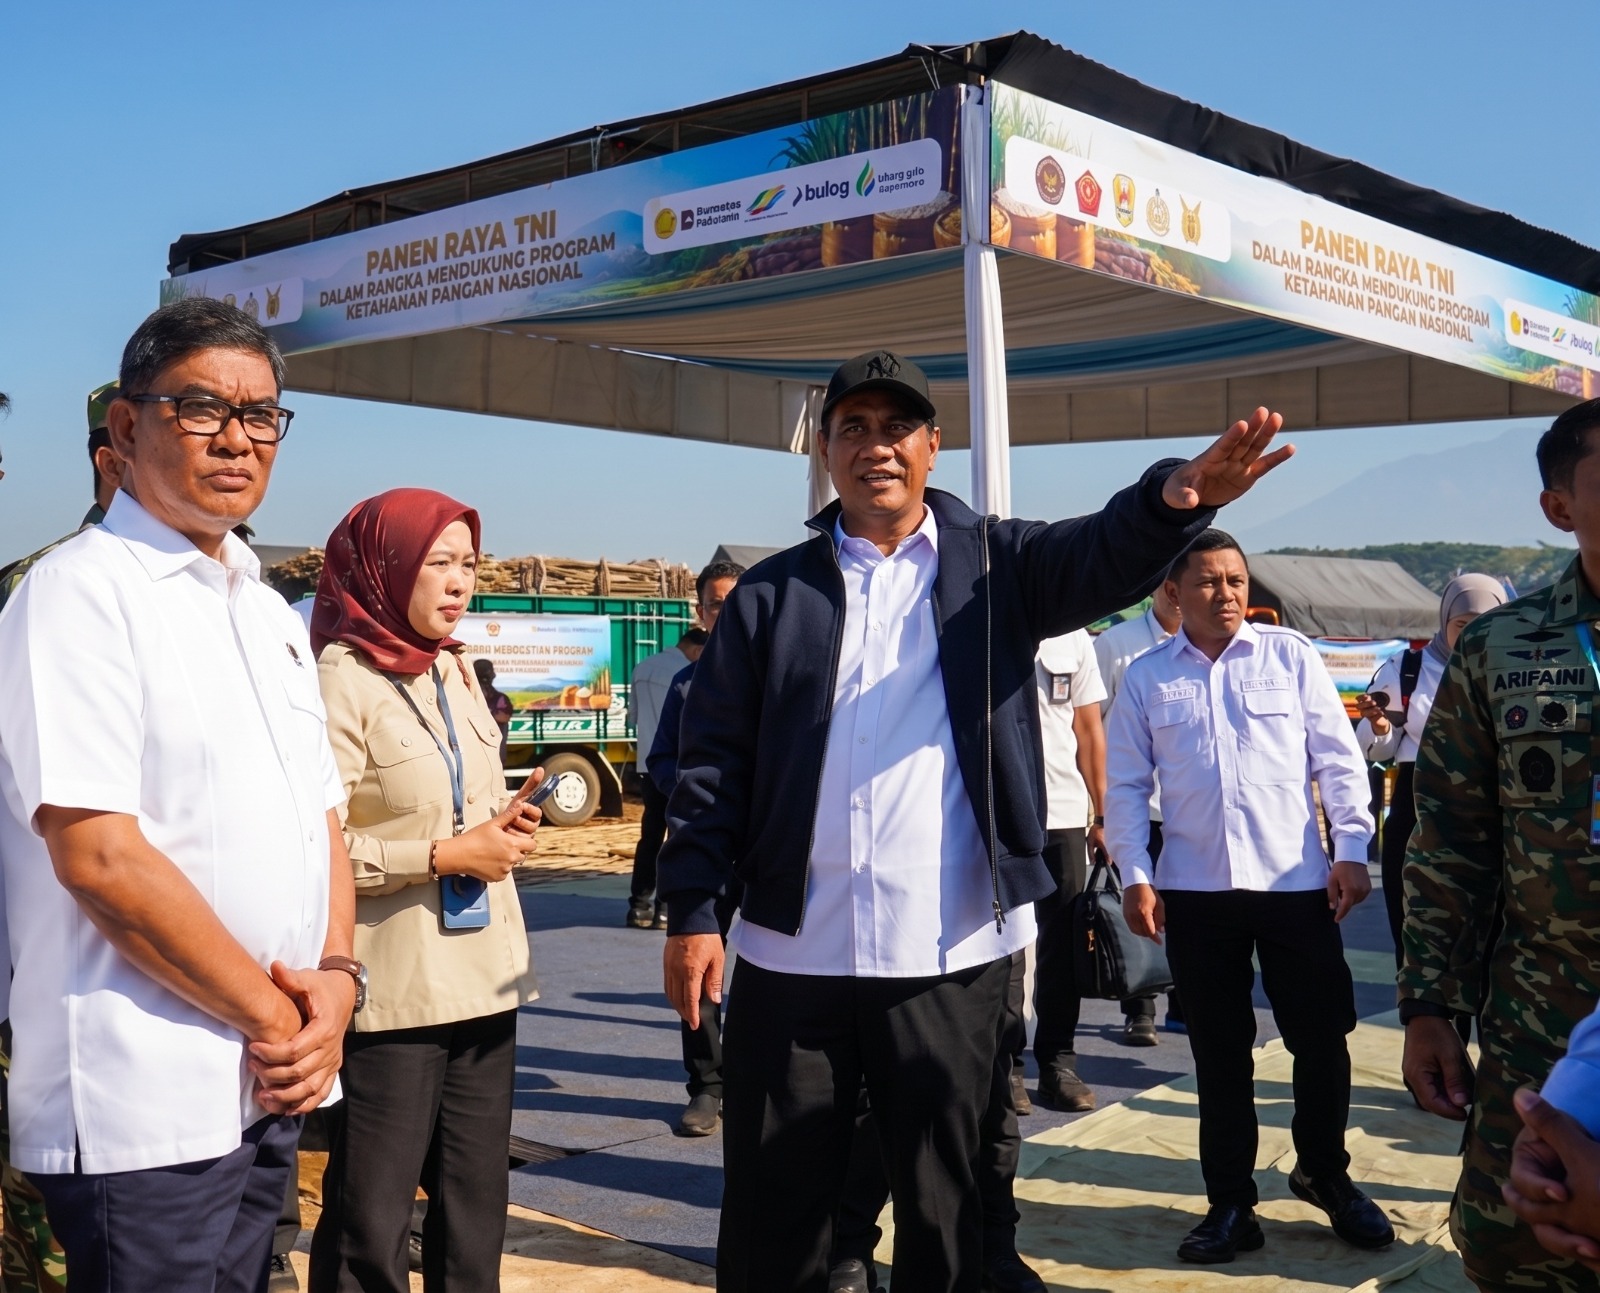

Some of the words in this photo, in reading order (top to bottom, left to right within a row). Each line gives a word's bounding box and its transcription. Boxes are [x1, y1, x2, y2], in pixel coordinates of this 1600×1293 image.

[805, 180, 850, 201] bulog
[320, 283, 364, 308] DALAM
[367, 272, 424, 298] RANGKA
[427, 250, 525, 286] MENDUKUNG
[530, 231, 616, 266] PROGRAM
[366, 236, 438, 277] PANEN
[444, 221, 507, 260] RAYA
[514, 209, 556, 245] TNI
[1300, 219, 1369, 269] PANEN
[1374, 244, 1422, 287] RAYA
[1426, 262, 1455, 296] TNI
[346, 290, 428, 320] KETAHANAN
[432, 277, 494, 305] PANGAN
[498, 261, 583, 293] NASIONAL
[1252, 240, 1301, 273] DALAM
[1305, 256, 1359, 290] RANGKA
[1362, 274, 1436, 312] MENDUKUNG
[1438, 297, 1490, 329] PROGRAM
[1284, 272, 1364, 312] KETAHANAN
[1367, 296, 1417, 327] PANGAN
[1419, 311, 1474, 343] NASIONAL
[553, 646, 594, 656] PROGRAM
[1493, 668, 1586, 693] ARIFAINI
